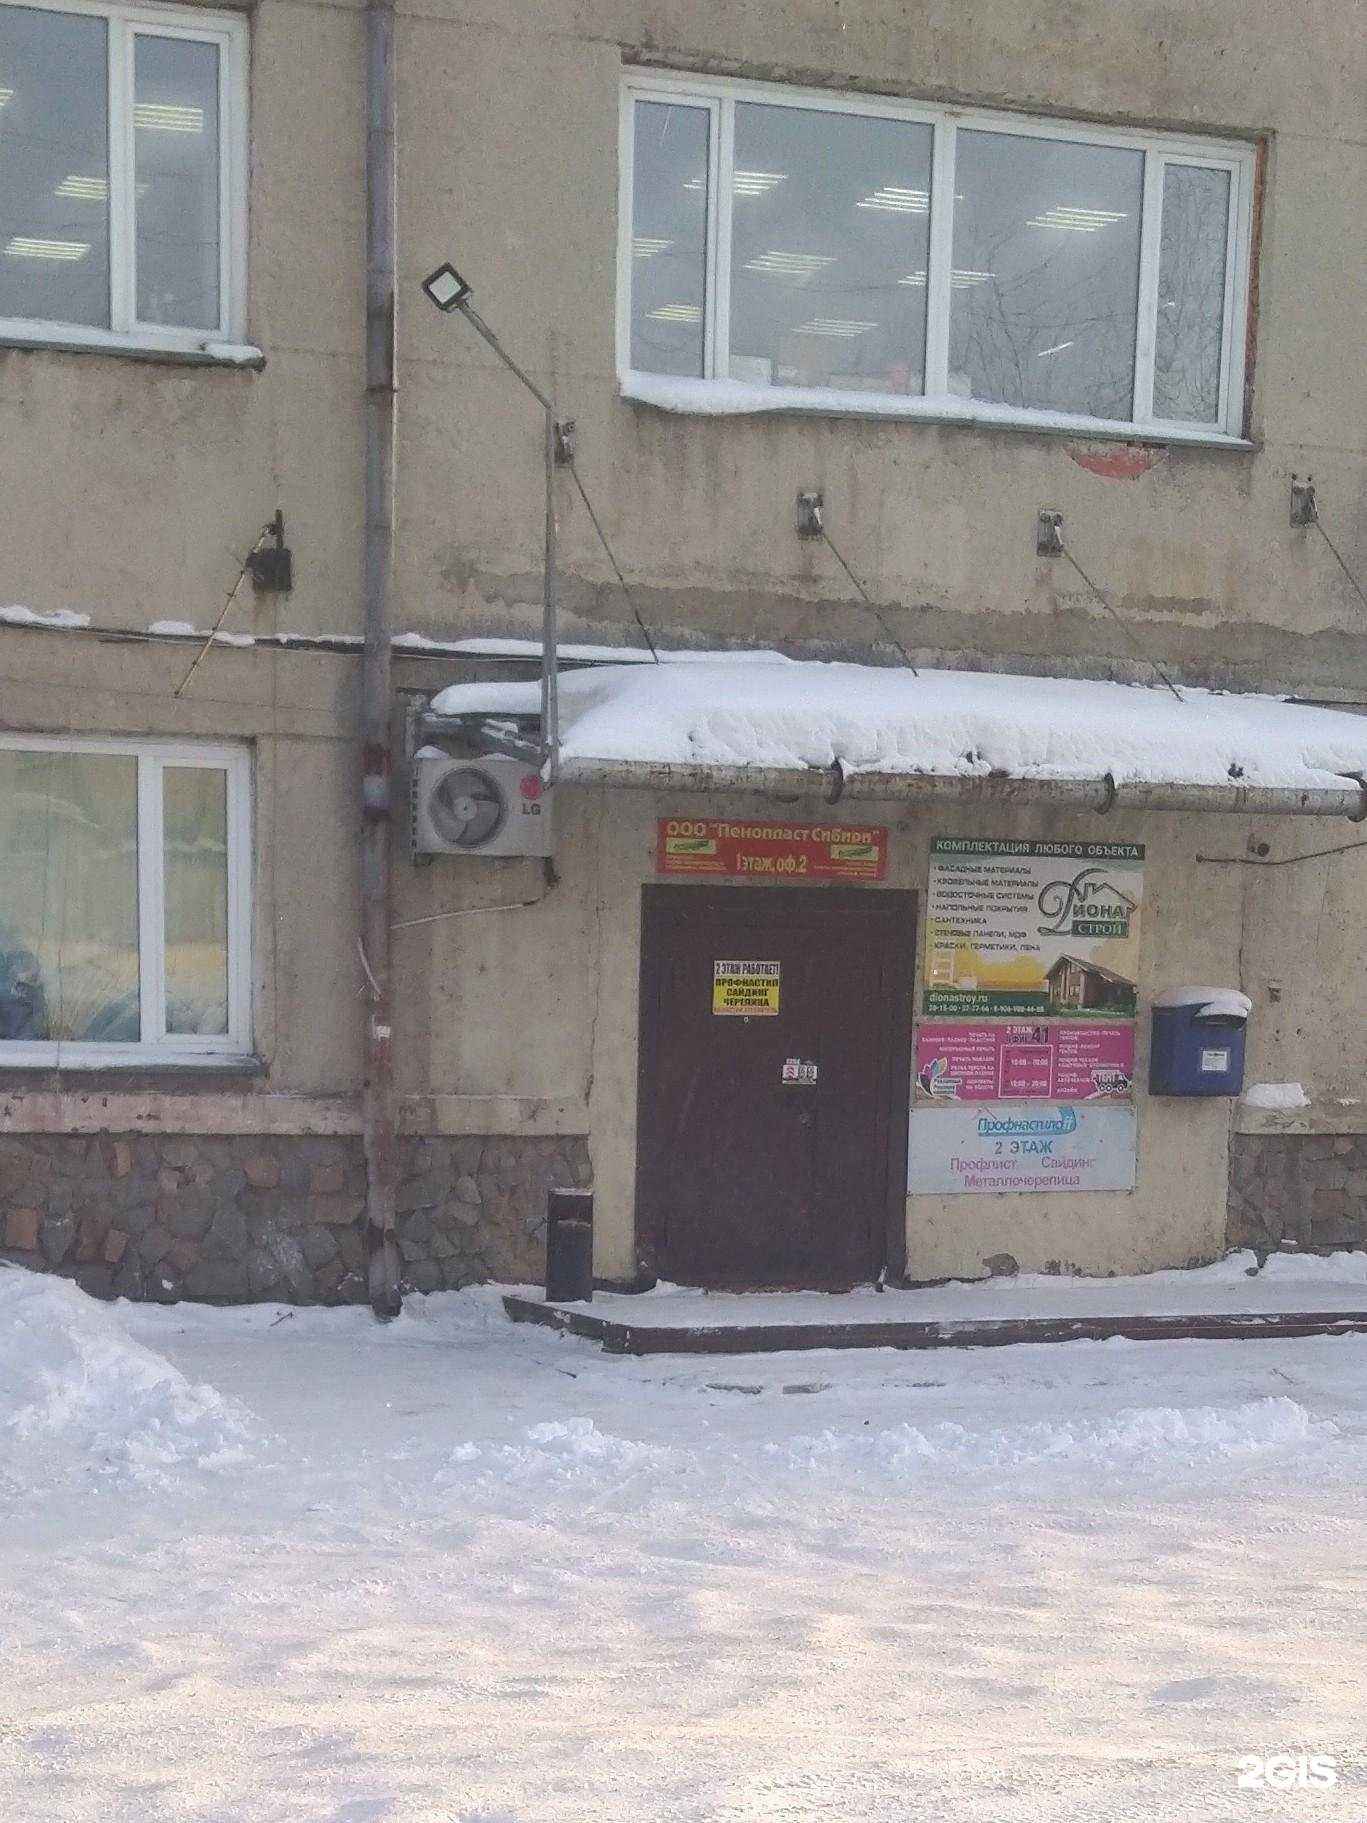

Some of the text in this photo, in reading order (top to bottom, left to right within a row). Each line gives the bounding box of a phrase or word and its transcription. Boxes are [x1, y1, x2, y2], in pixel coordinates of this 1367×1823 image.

[522, 803, 541, 815] LG
[666, 822, 707, 838] ООО
[936, 840, 1139, 856] КОМПЛЕКТАЦИЯ ЛЮБОГО ОБЪЕКТА
[1078, 923, 1125, 936] СТРОЙ
[994, 1141, 1054, 1155] 2 ЭТАЖ
[950, 1156, 1096, 1172] Профлист Сайдинг
[964, 1175, 1081, 1189] Металлочерепица
